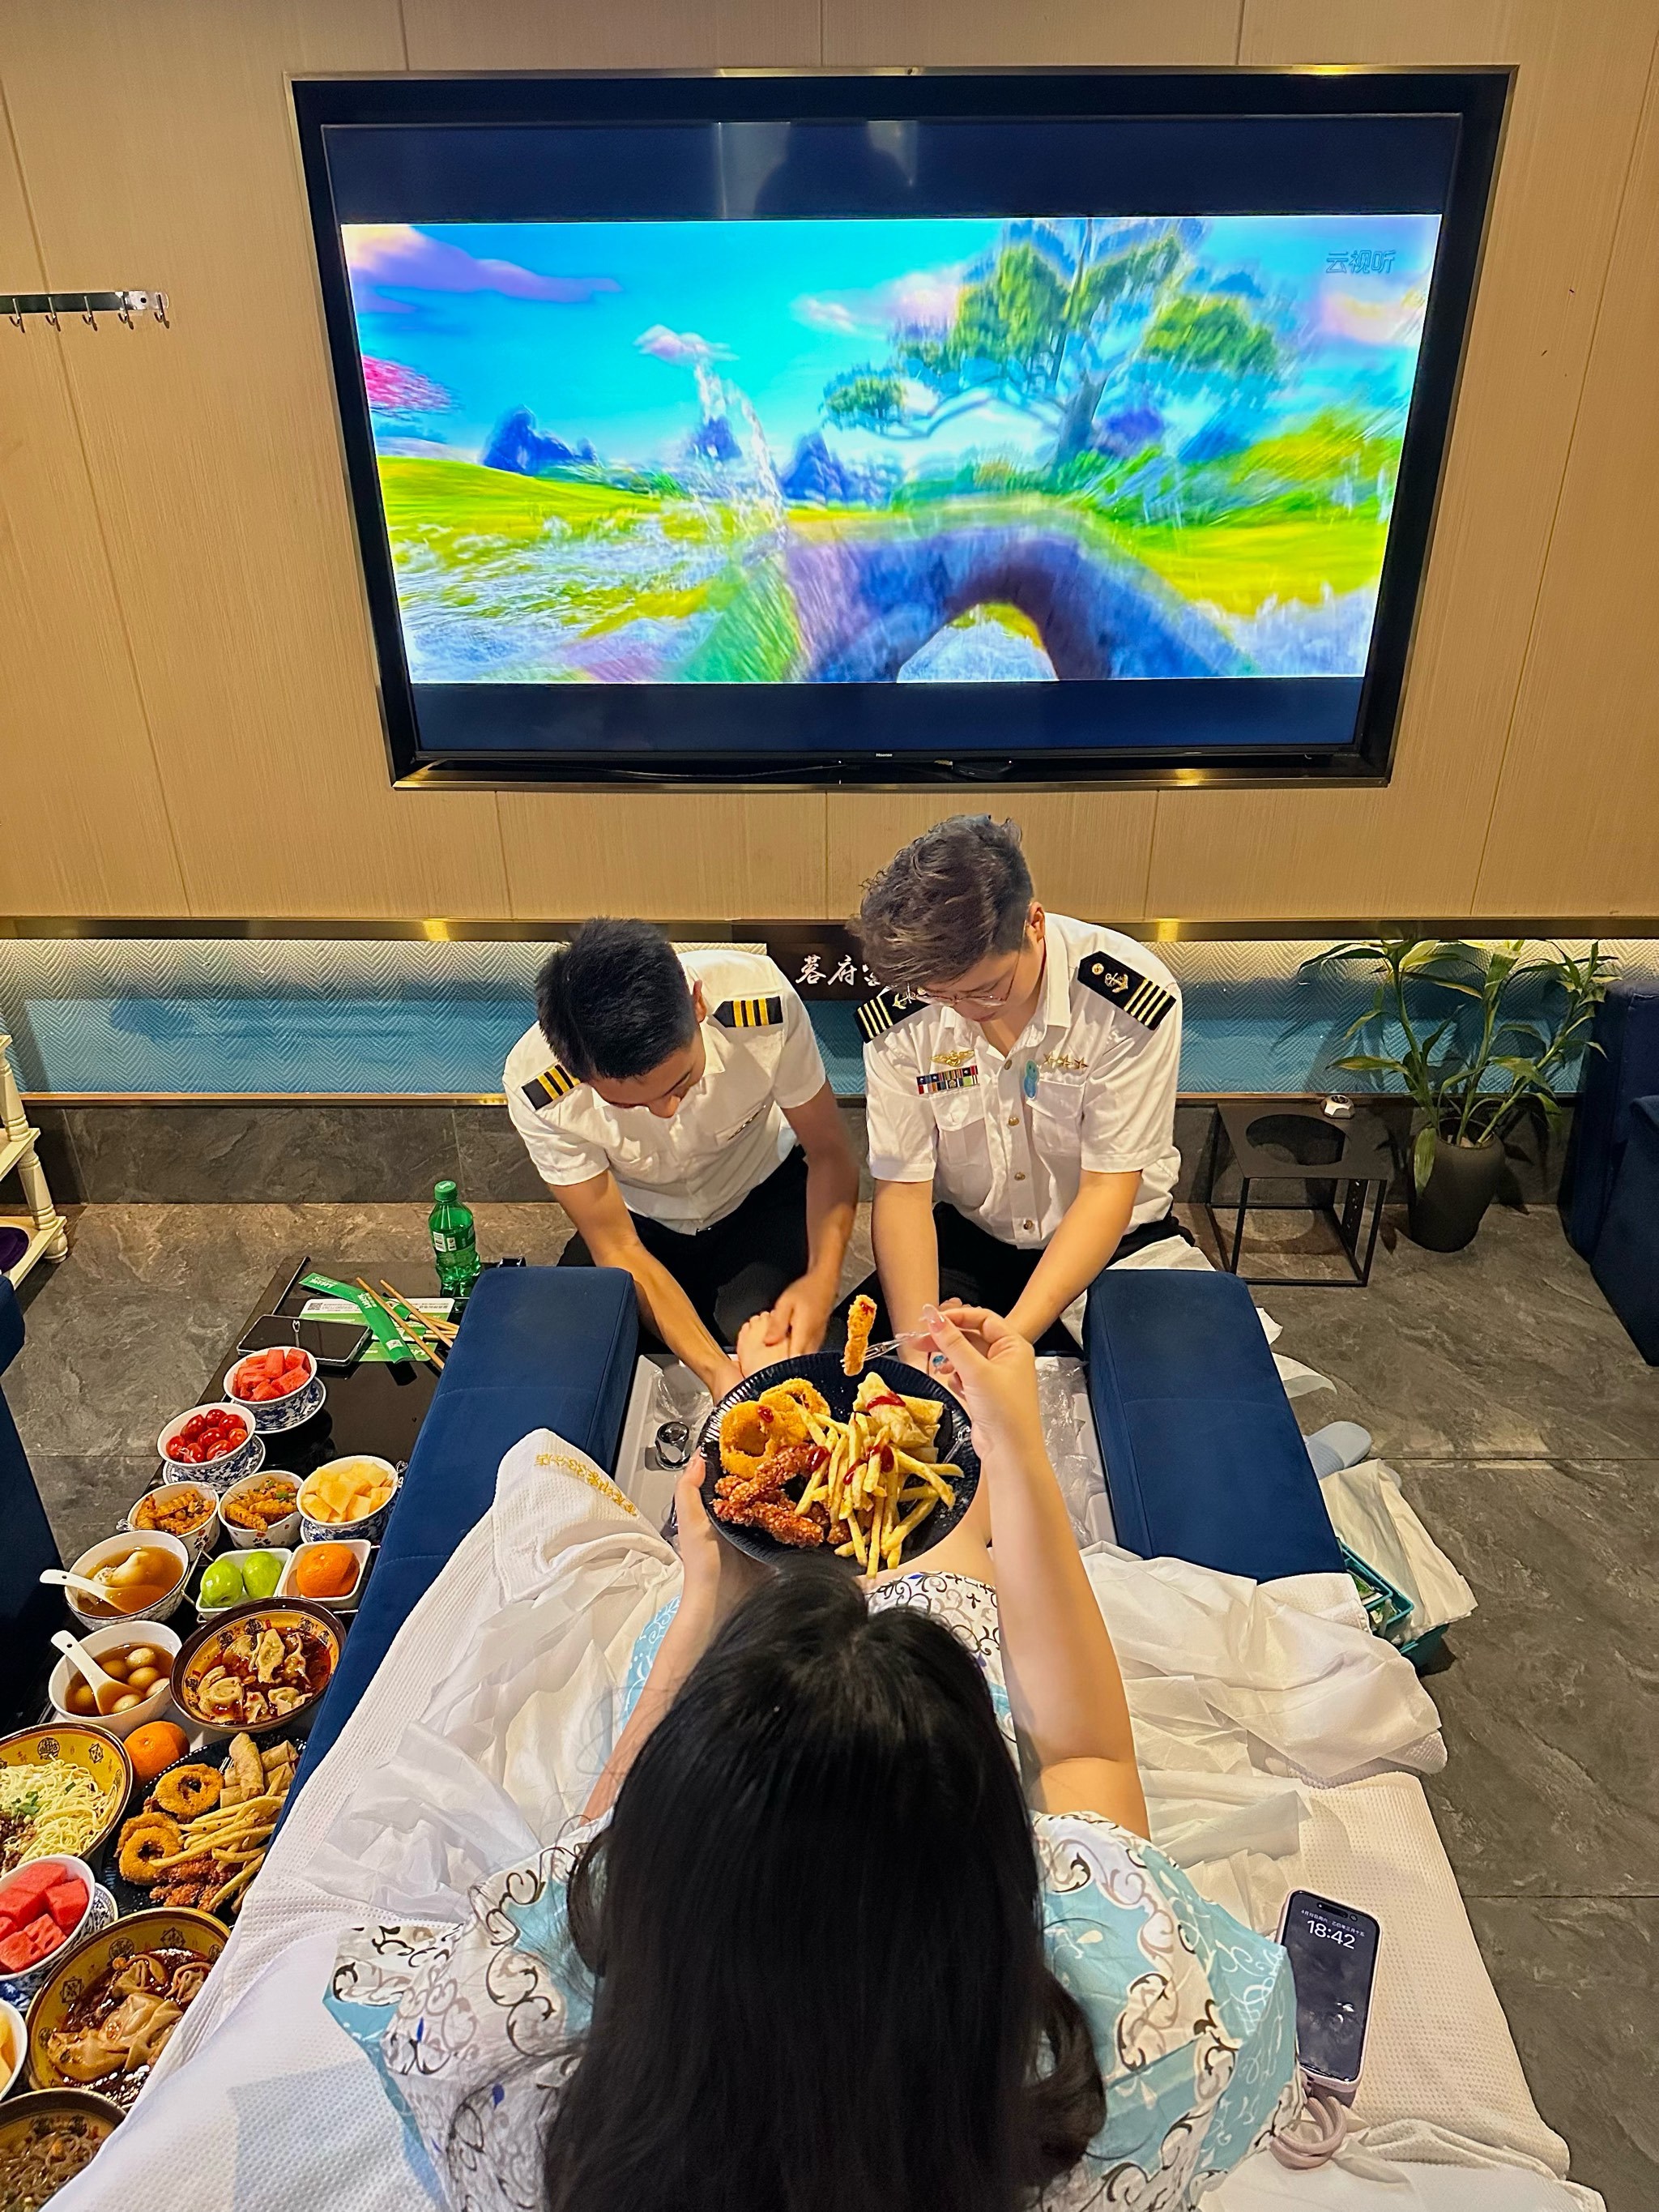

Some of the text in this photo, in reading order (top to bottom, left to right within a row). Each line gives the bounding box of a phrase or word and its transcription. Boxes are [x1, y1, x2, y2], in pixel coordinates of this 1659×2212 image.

[1326, 250, 1396, 274] 云视听
[1307, 1919, 1356, 1949] 18:42
